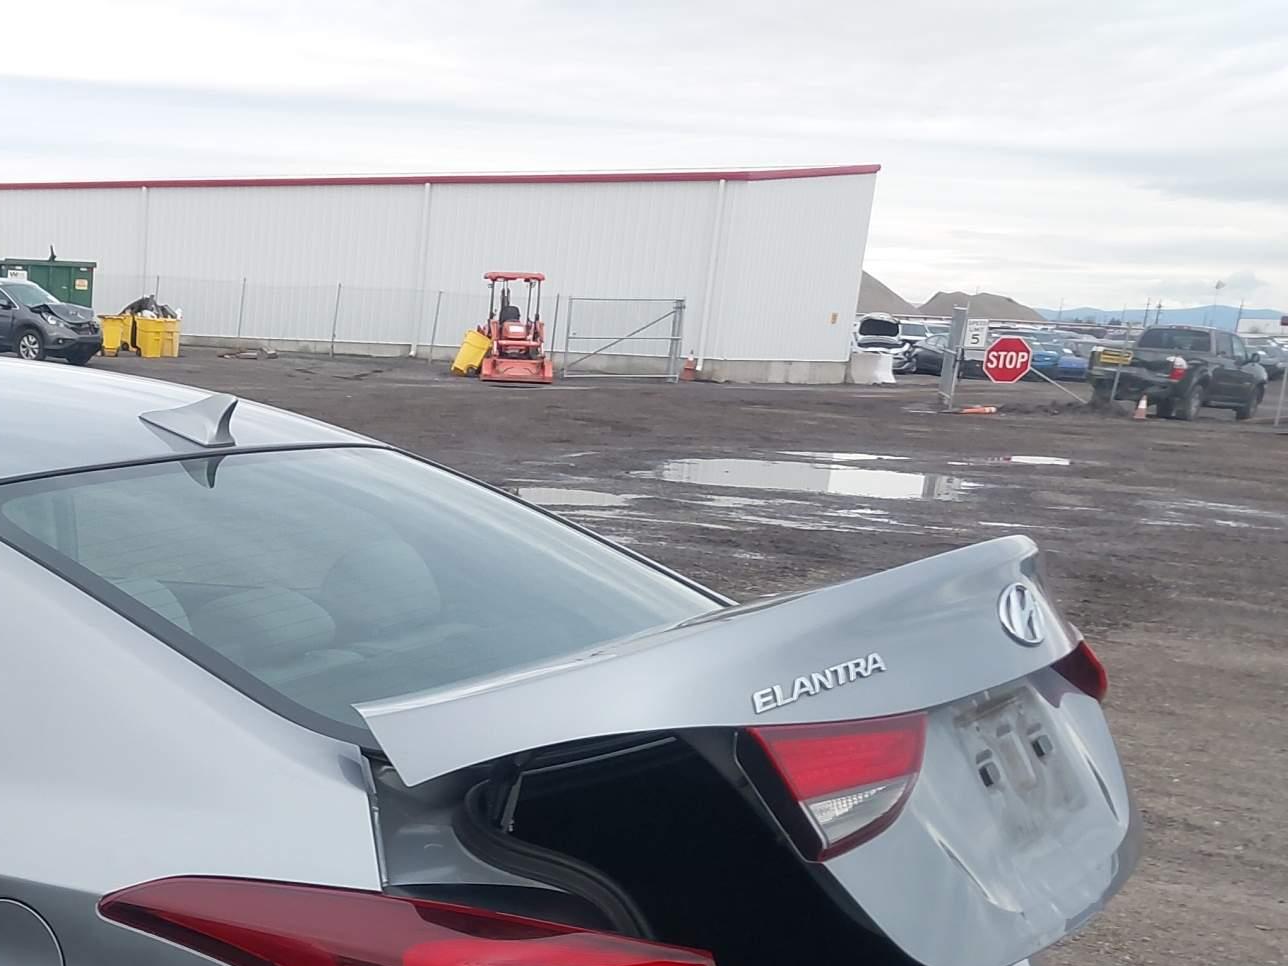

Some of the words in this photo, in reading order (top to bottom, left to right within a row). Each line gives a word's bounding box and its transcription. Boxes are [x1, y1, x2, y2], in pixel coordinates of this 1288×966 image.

[971, 334, 980, 344] 5
[987, 351, 1029, 369] STOP
[752, 652, 887, 714] ELANTRA
